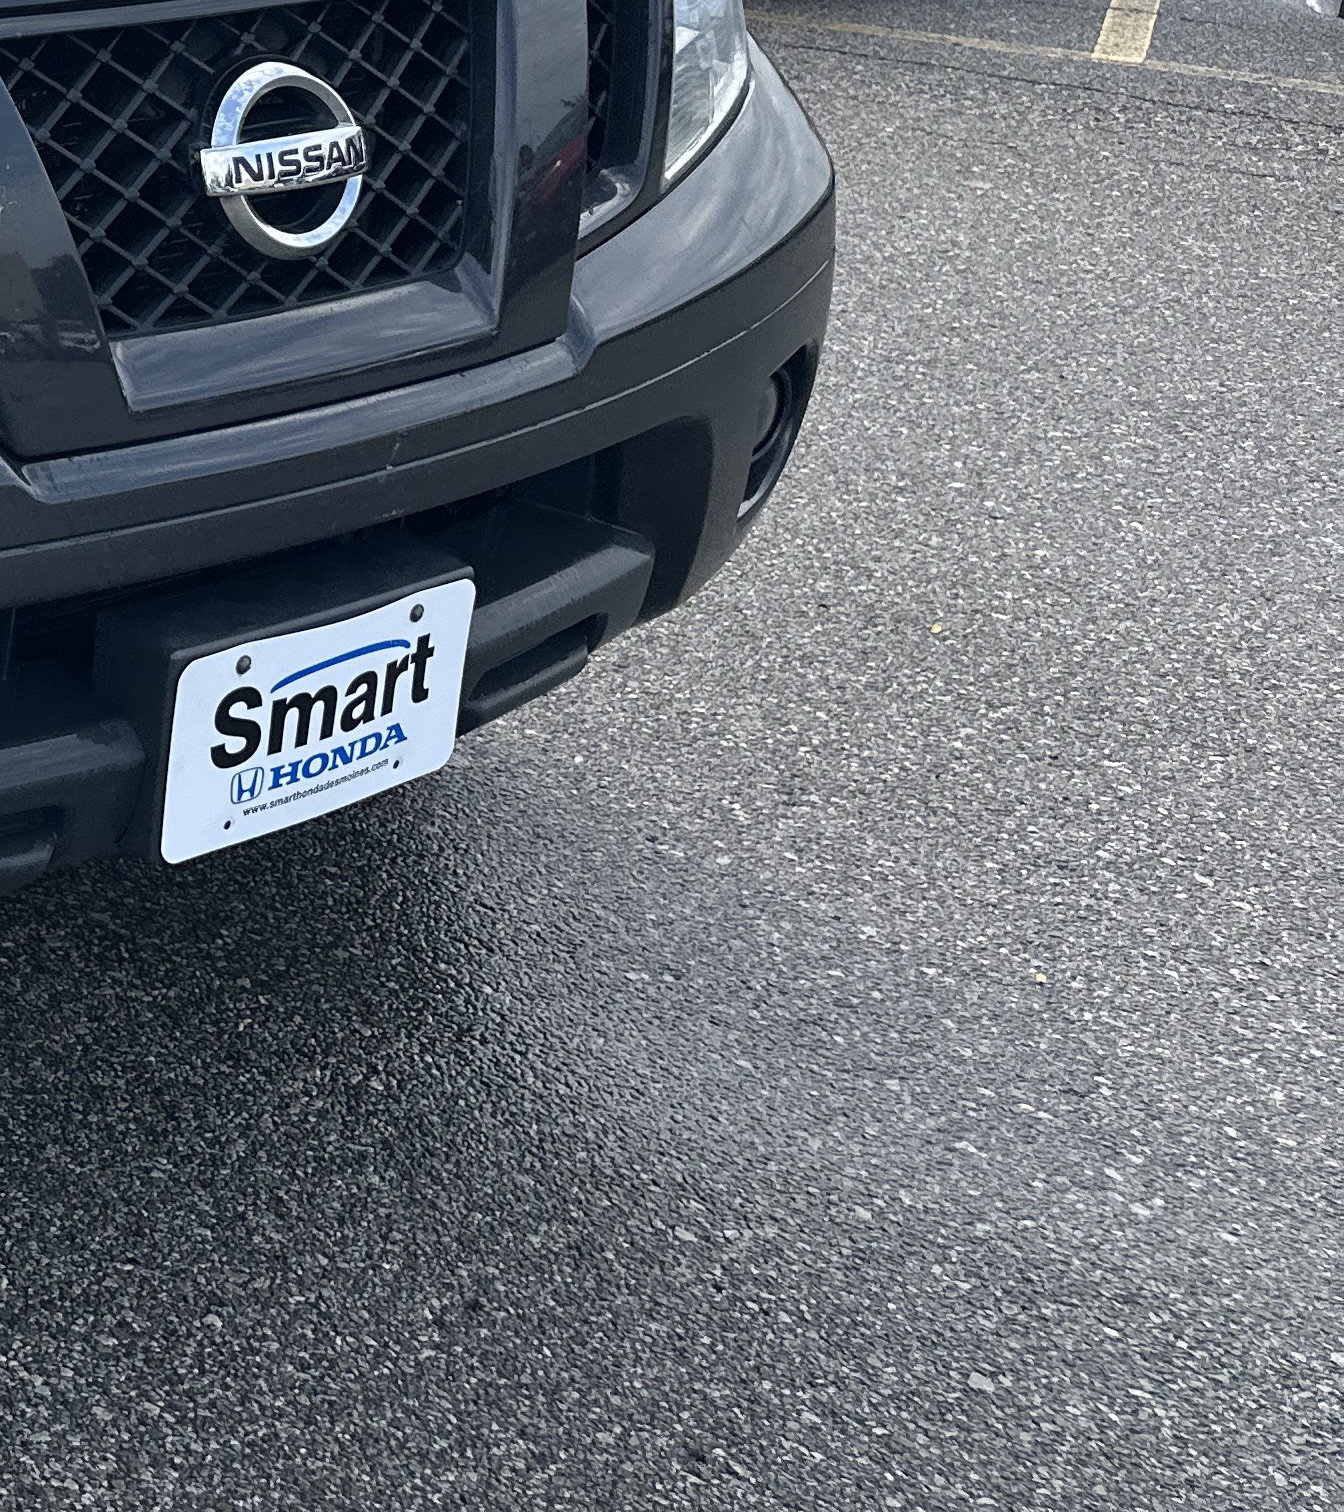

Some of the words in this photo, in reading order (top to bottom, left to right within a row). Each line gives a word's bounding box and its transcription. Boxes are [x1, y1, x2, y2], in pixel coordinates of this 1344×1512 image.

[231, 134, 365, 185] NISSAN
[210, 633, 435, 769] Smart
[267, 722, 407, 791] HONDA
